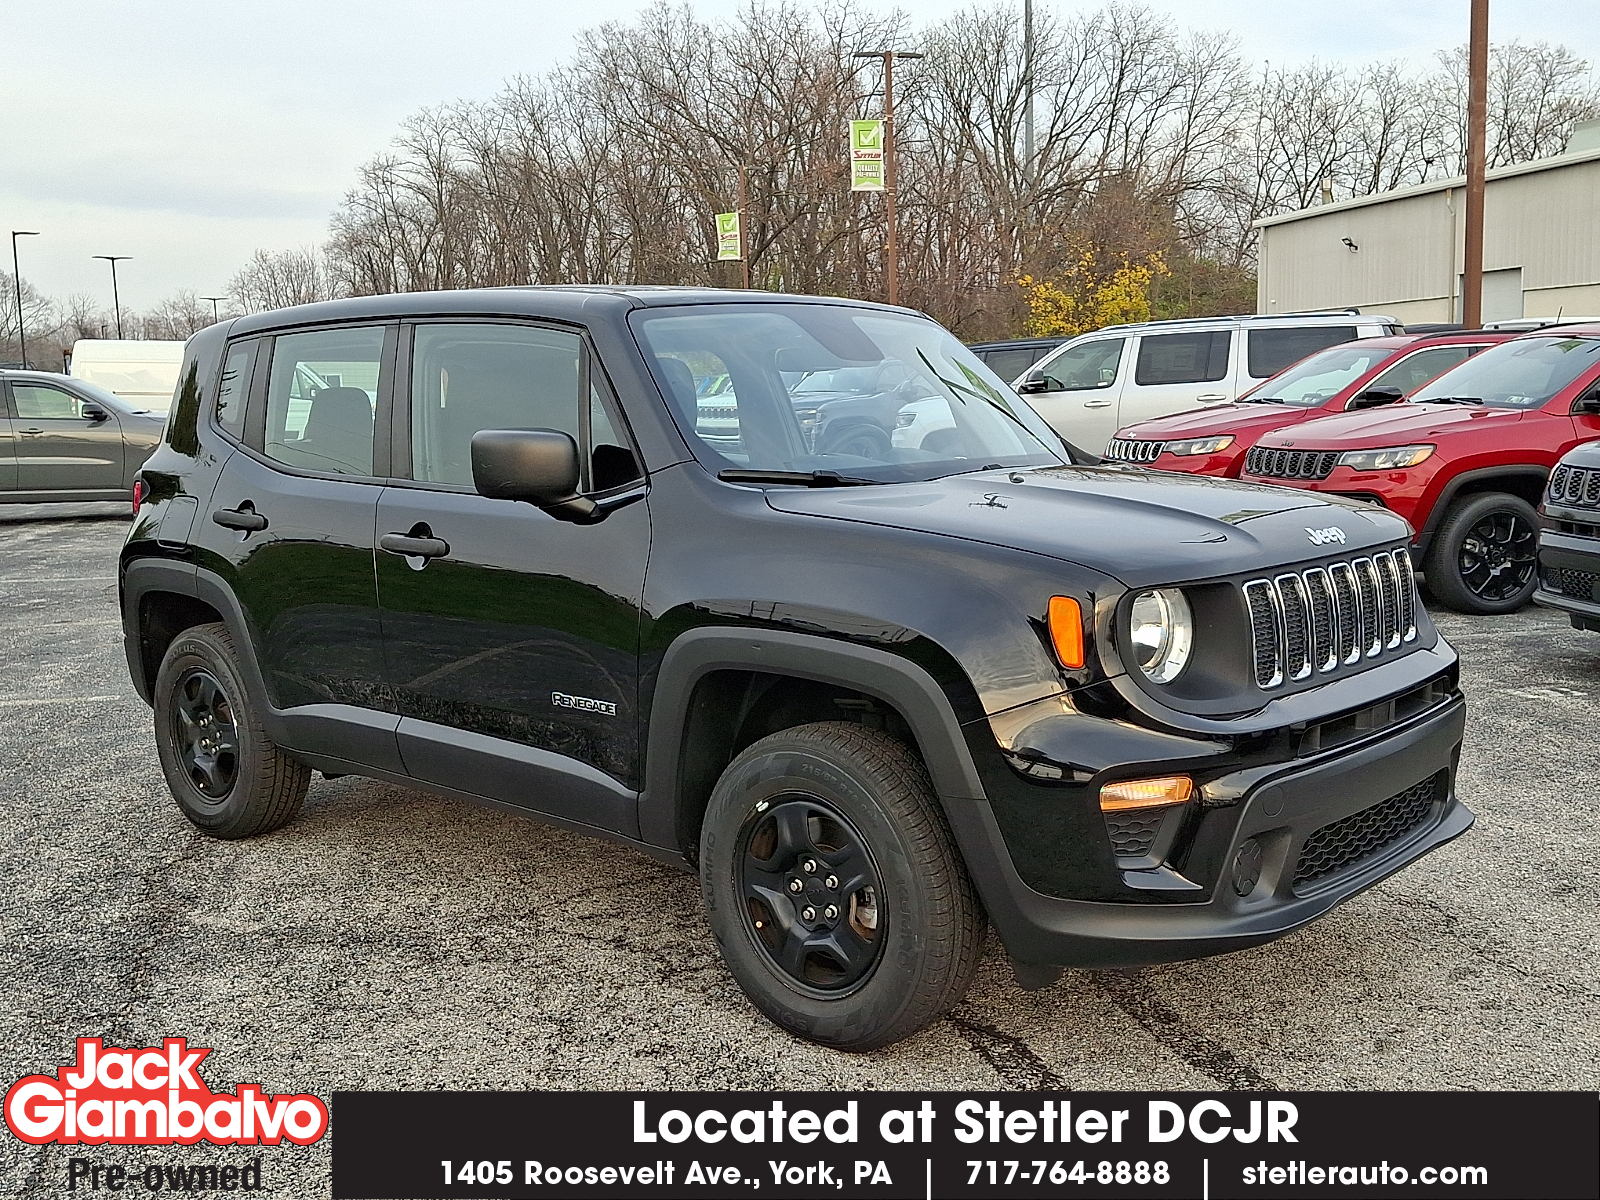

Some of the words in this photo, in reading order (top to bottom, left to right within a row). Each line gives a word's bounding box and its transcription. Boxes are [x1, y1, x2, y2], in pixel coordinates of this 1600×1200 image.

[1304, 526, 1346, 546] Jeep
[551, 692, 617, 716] RENEGADE
[705, 831, 718, 912] KUMHO
